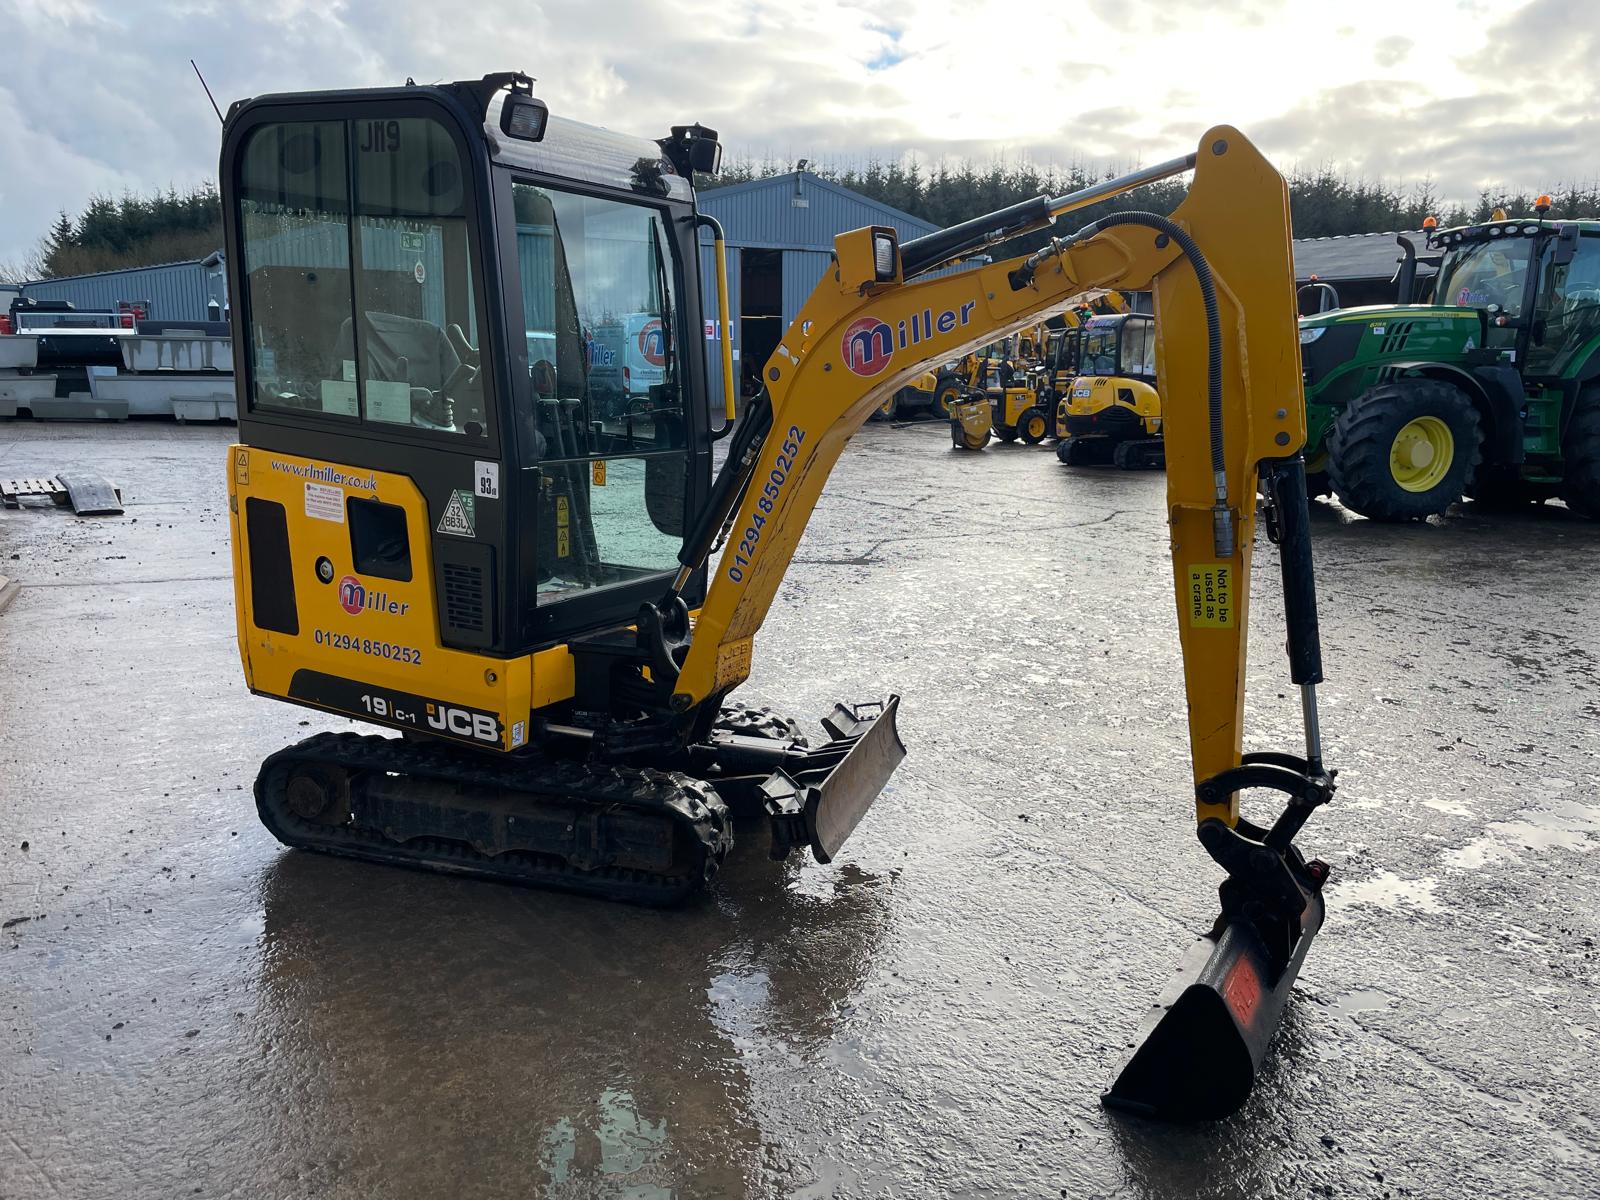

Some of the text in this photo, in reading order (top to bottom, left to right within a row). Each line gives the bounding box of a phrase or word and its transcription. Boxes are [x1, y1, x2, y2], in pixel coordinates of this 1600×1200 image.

[271, 461, 377, 490] www.rlmiller.co.uk
[480, 477, 492, 494] 93
[451, 506, 460, 517] 32
[1193, 584, 1202, 619] crane.
[1205, 573, 1216, 619] used as
[1217, 569, 1229, 622] Not to be
[427, 705, 499, 742] JCB
